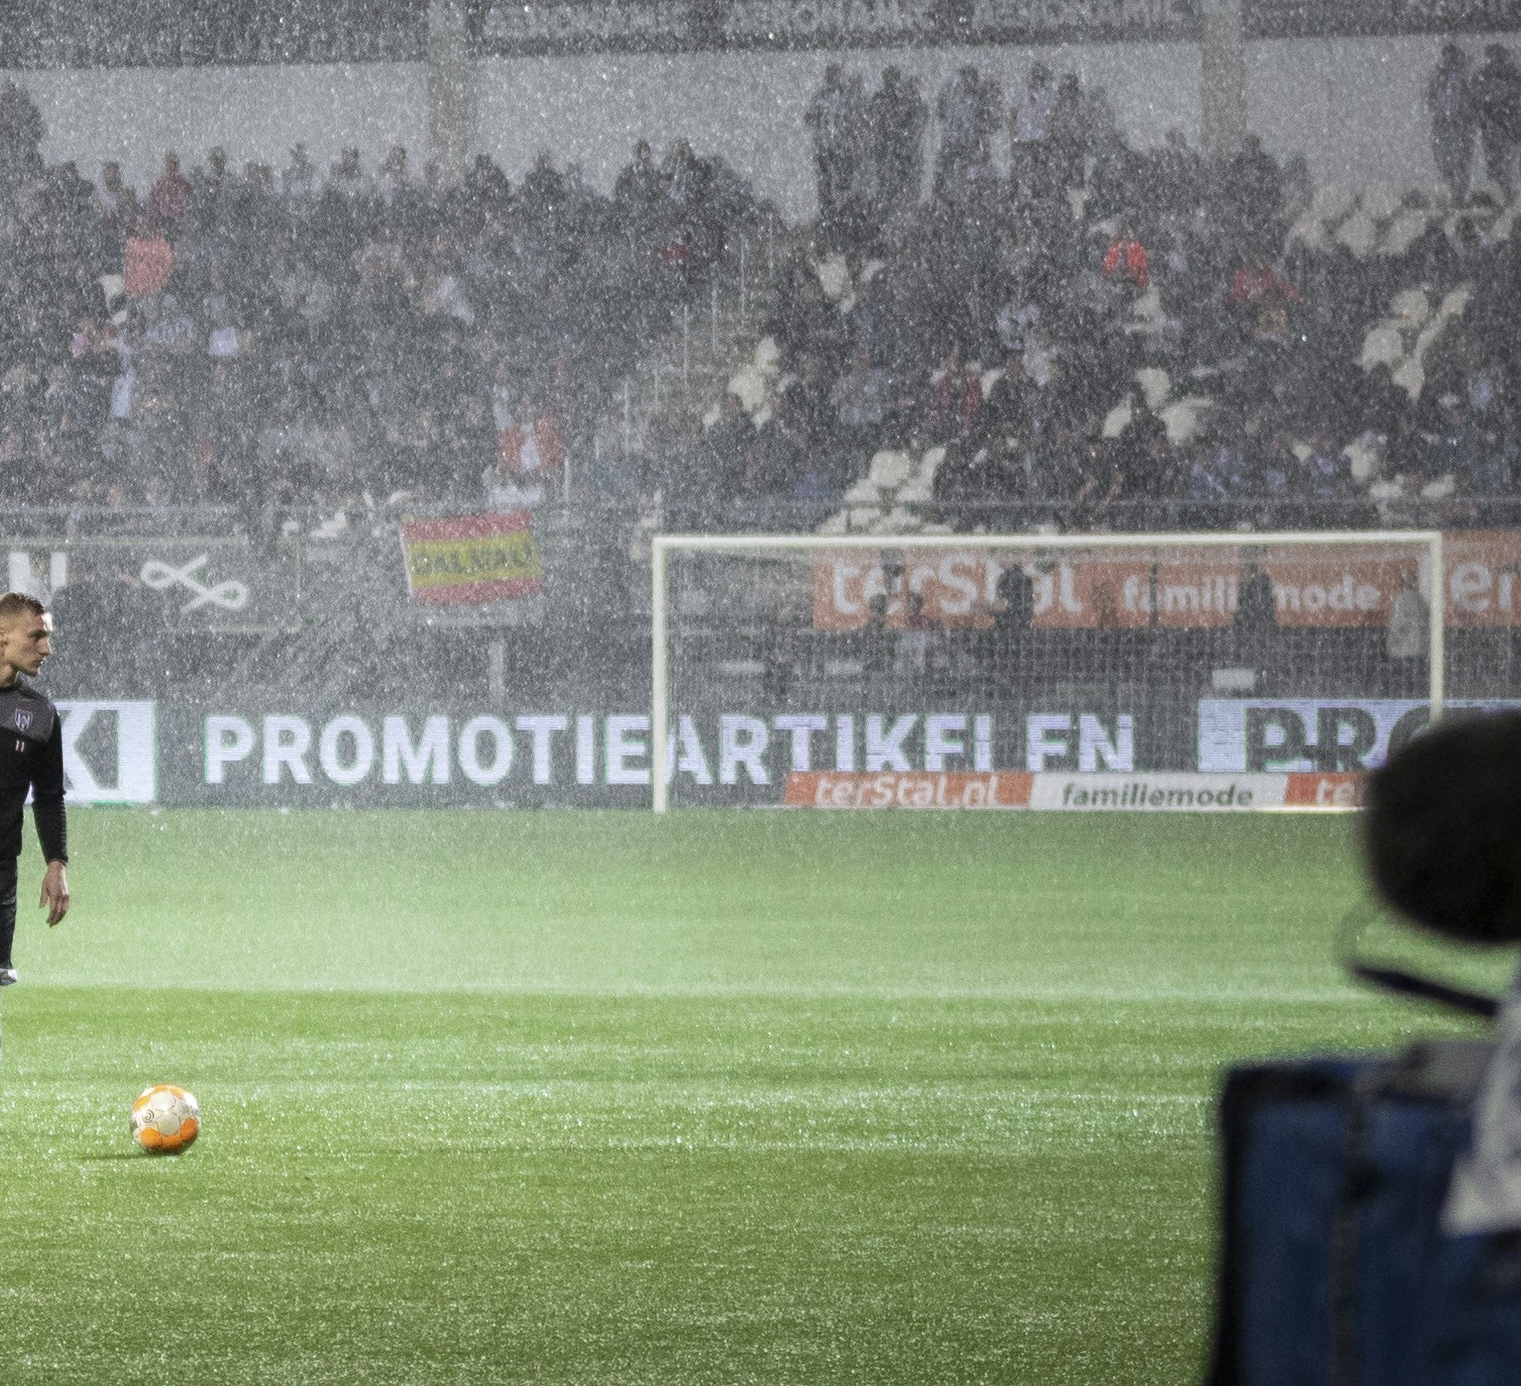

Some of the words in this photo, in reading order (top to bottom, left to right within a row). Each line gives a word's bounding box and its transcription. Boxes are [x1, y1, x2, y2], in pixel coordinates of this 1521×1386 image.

[1121, 575, 1382, 613] familimode
[815, 774, 1000, 807] terStal.nl
[1061, 781, 1255, 807] familiemode
